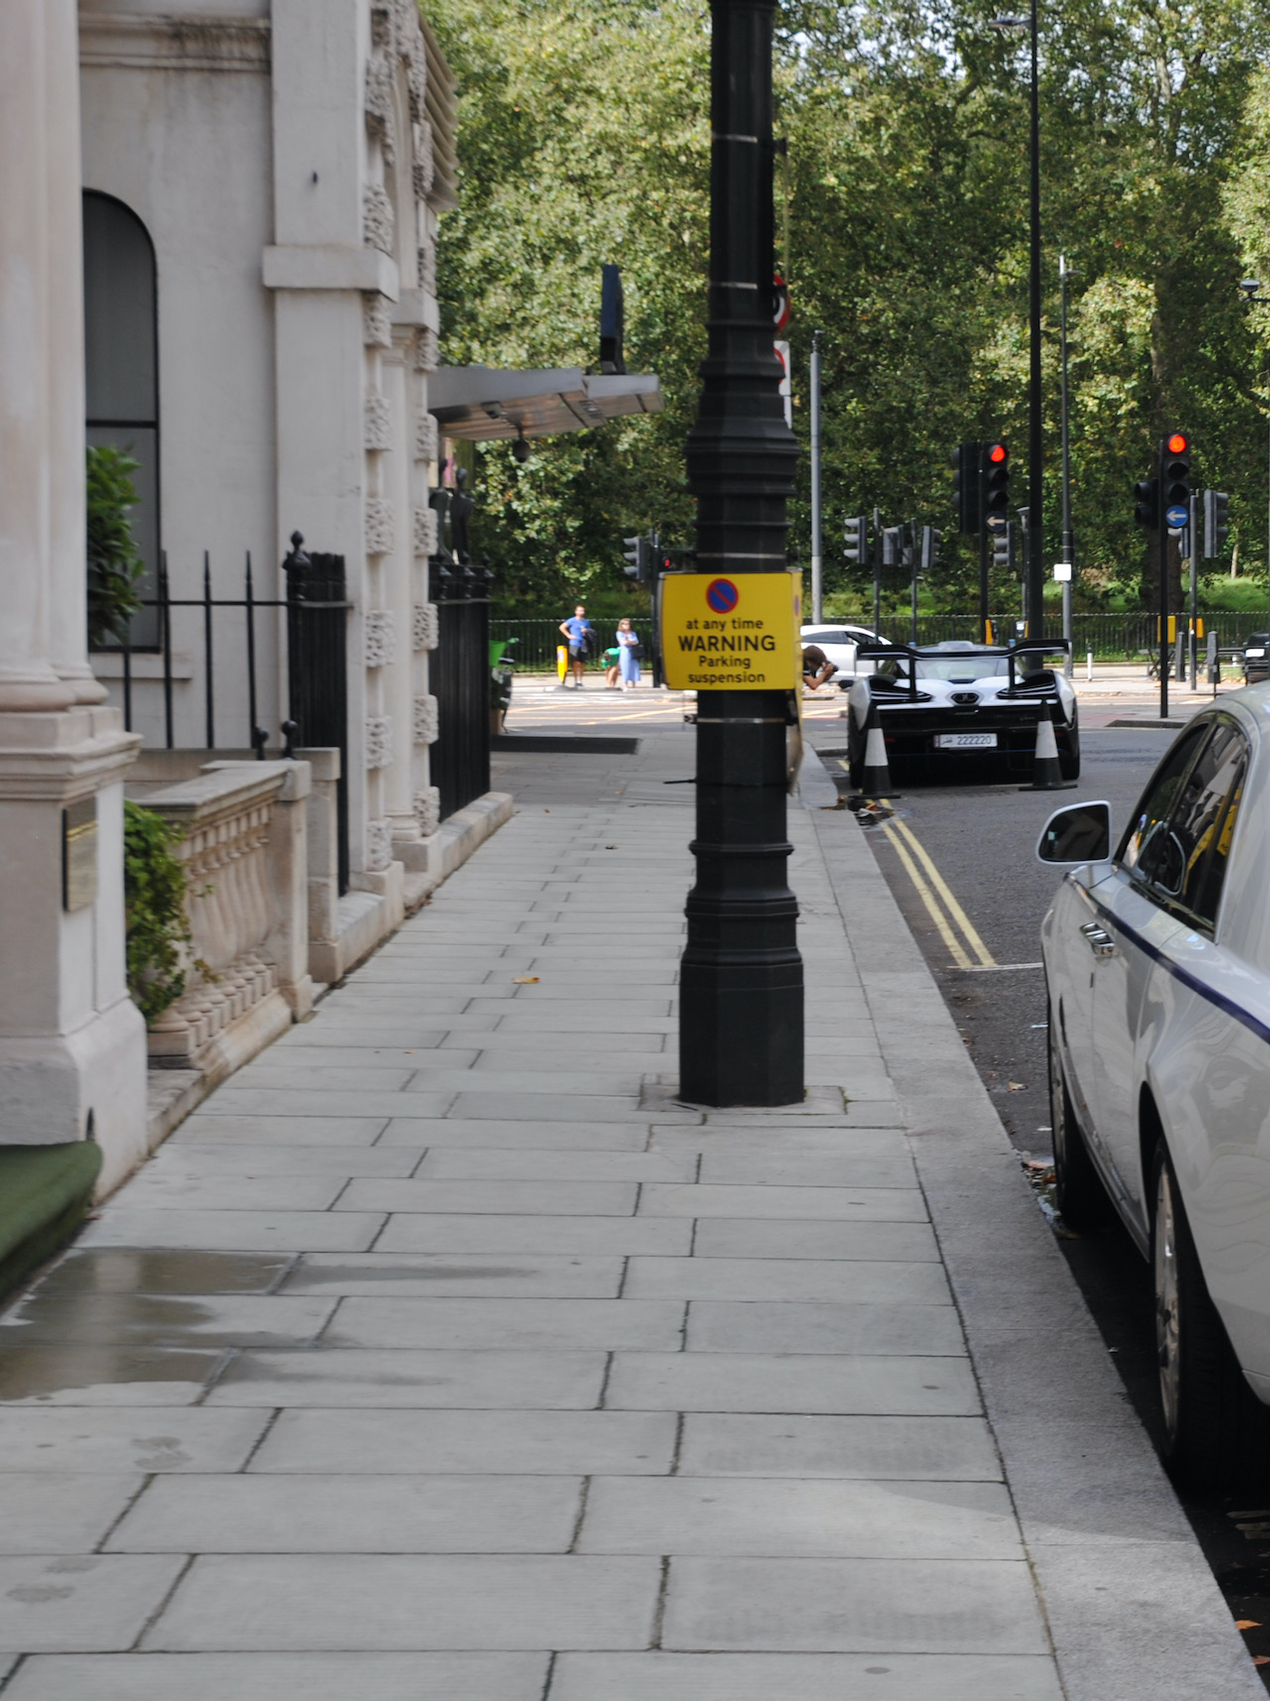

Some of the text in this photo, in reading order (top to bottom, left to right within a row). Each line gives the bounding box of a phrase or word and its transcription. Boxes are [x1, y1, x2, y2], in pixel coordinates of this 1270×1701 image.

[686, 618, 763, 632] at any time
[678, 635, 776, 652] WARNING
[699, 655, 751, 669] Parking
[688, 672, 766, 685] suspension
[957, 735, 992, 745] 222220
